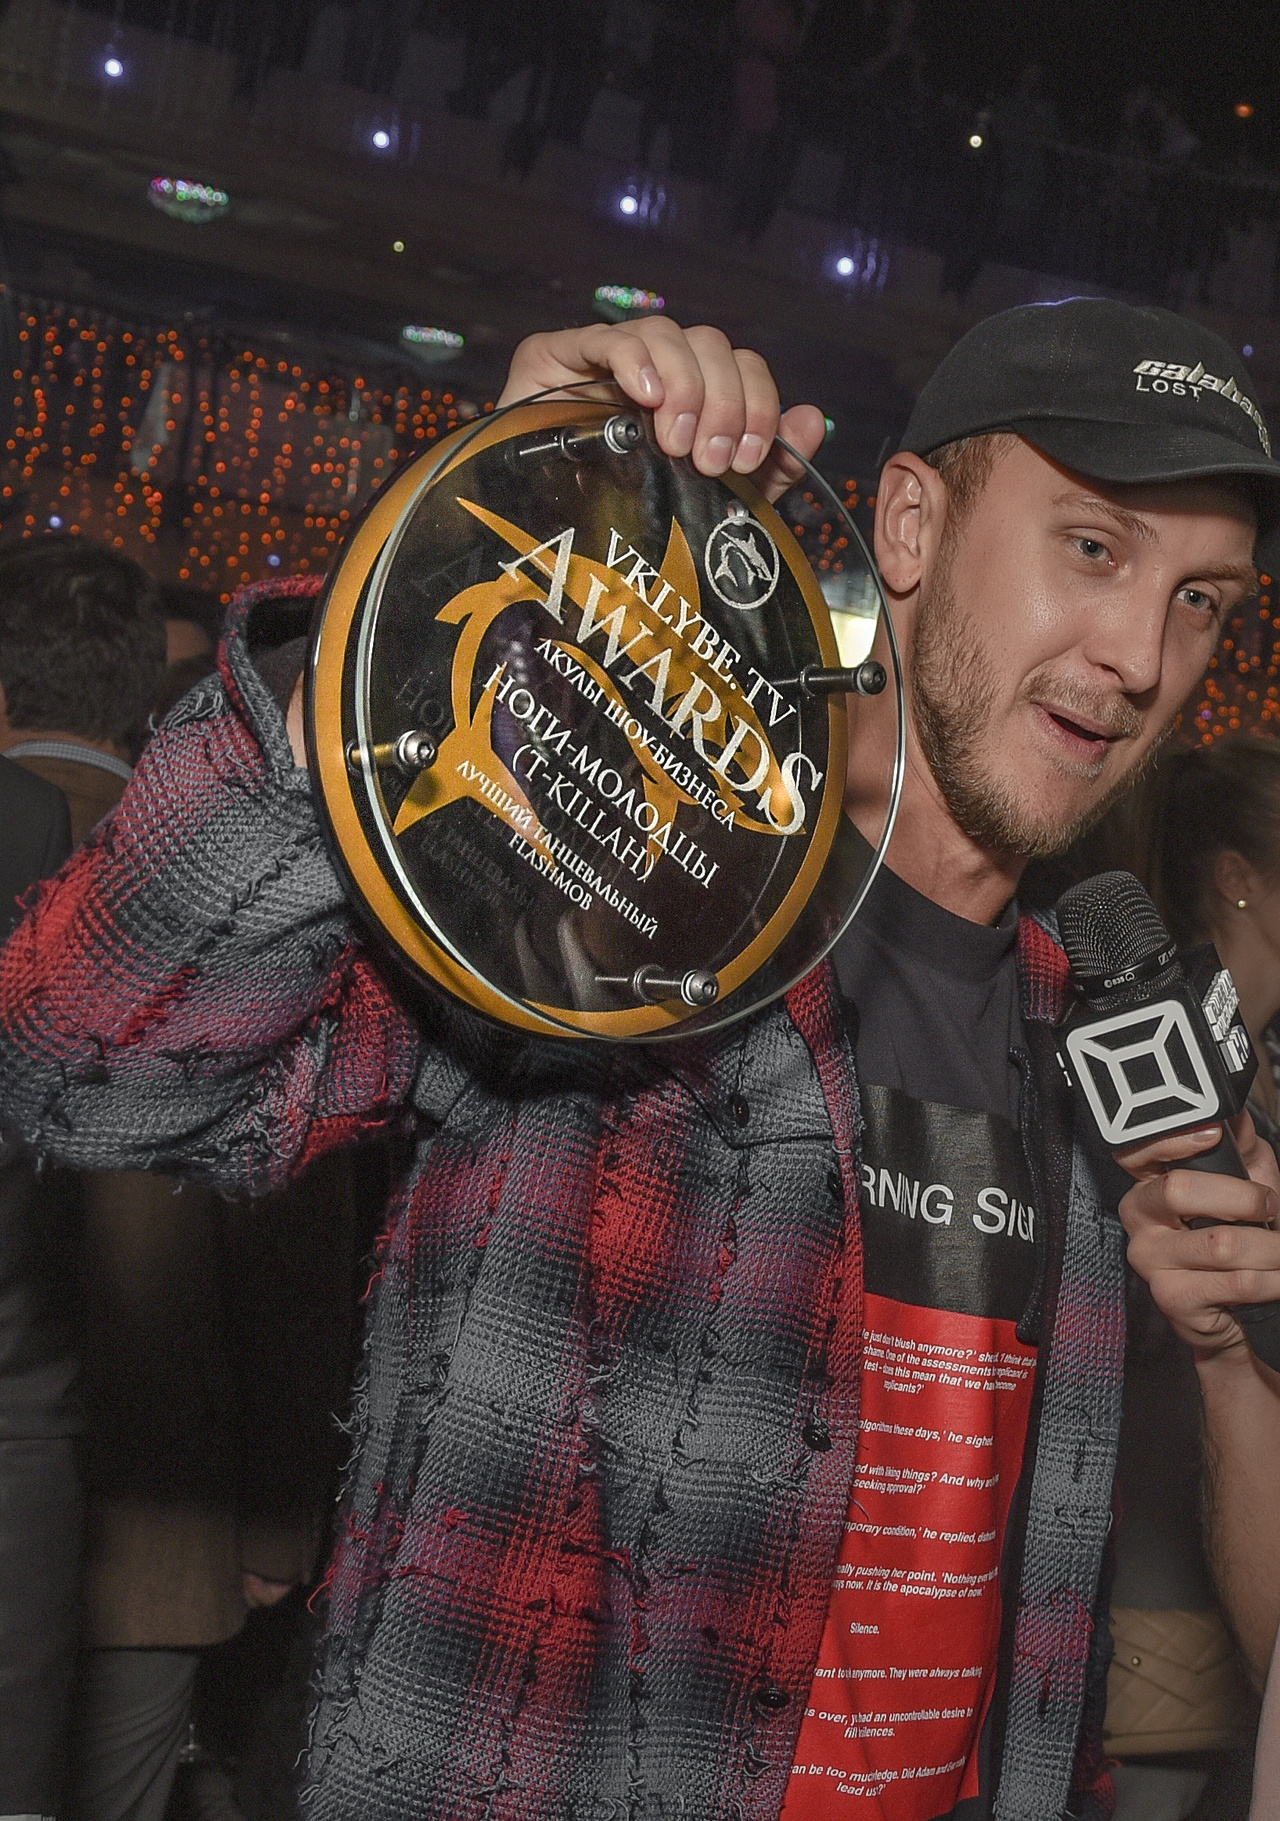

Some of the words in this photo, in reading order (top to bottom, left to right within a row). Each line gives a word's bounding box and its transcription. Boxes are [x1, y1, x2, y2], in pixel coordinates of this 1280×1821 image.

[1136, 375, 1203, 403] LOST
[498, 527, 824, 835] AWARDS
[533, 638, 606, 707] АКУЛЫ
[603, 697, 737, 833] ШОУ-БИЗНЕСА
[482, 663, 720, 889] НОГИ-МОЛОДЦЫ
[512, 744, 656, 883] (T-KILLAH)
[456, 759, 534, 831] ЛУЧШИЙ
[533, 821, 660, 940] ТАНЦЕВАЛЬНЫЙ
[508, 832, 595, 912] FLASHMOB
[895, 1336, 916, 1351] blush
[917, 1343, 977, 1360] anymore?'
[863, 1359, 879, 1373] test
[894, 1366, 911, 1379] this
[912, 1370, 936, 1382] mean
[938, 1373, 963, 1386] that
[964, 1378, 982, 1390] we
[896, 1352, 907, 1364] of
[907, 1354, 921, 1366] the
[921, 1358, 992, 1377] assessments
[893, 1423, 914, 1436] these
[947, 1431, 963, 1443] he
[853, 1478, 886, 1494] seeking
[902, 1467, 938, 1483] things?
[939, 1473, 965, 1486] And
[966, 1477, 986, 1491] why
[922, 1527, 938, 1540] he
[939, 1531, 976, 1545] replied,
[855, 1565, 891, 1580] pushing
[891, 1567, 907, 1579] her
[907, 1569, 937, 1583] point.
[845, 1580, 865, 1590] now.
[873, 1579, 882, 1591] is
[882, 1580, 898, 1592] the
[900, 1584, 957, 1600] apocalypse
[958, 1586, 969, 1598] of
[850, 1622, 880, 1634] Silence.
[851, 1666, 888, 1681] anymore.
[889, 1666, 908, 1681] They
[908, 1667, 929, 1678] were
[818, 1710, 848, 1726] over,
[873, 1712, 887, 1723] an
[941, 1706, 966, 1719] desire
[844, 1727, 858, 1739] fill
[808, 1763, 824, 1775] be
[826, 1765, 848, 1779] too
[901, 1767, 916, 1780] Did
[837, 1781, 865, 1796] lead
